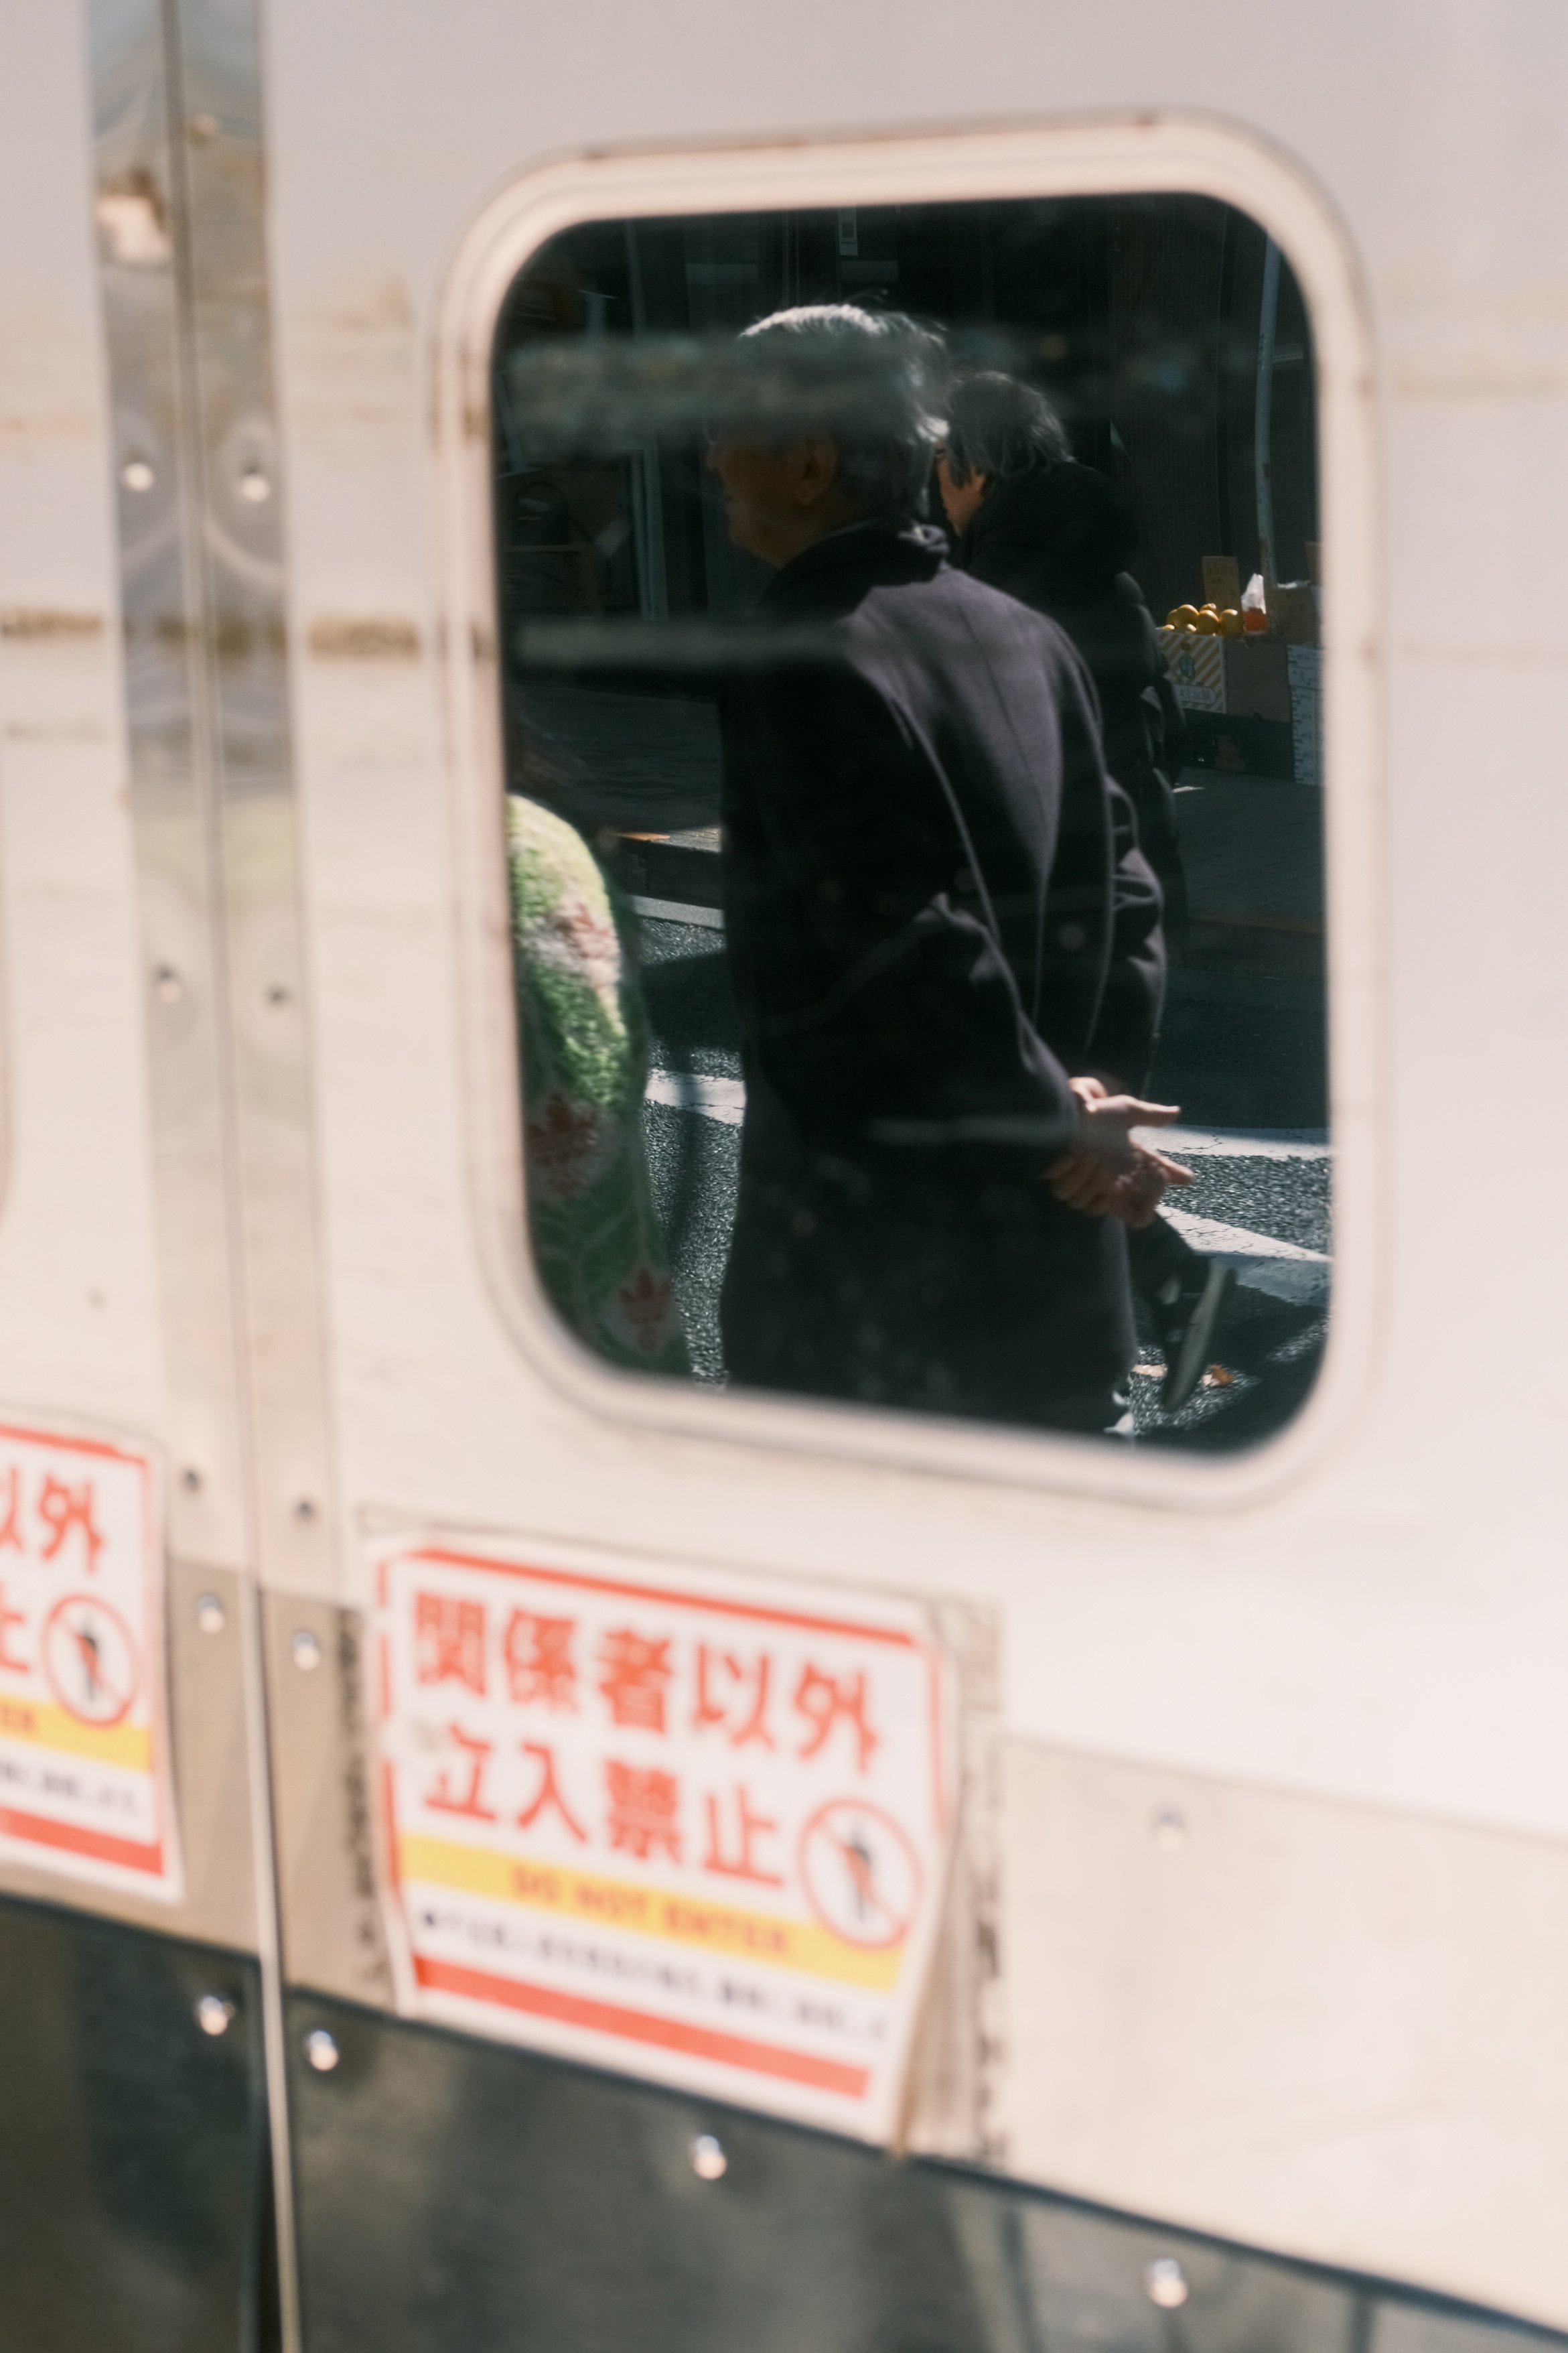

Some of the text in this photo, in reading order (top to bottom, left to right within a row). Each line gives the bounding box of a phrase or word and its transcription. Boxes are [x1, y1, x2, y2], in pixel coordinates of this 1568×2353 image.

[414, 1589, 879, 1775] 関係者以外
[423, 1722, 784, 1888] 立入禁止
